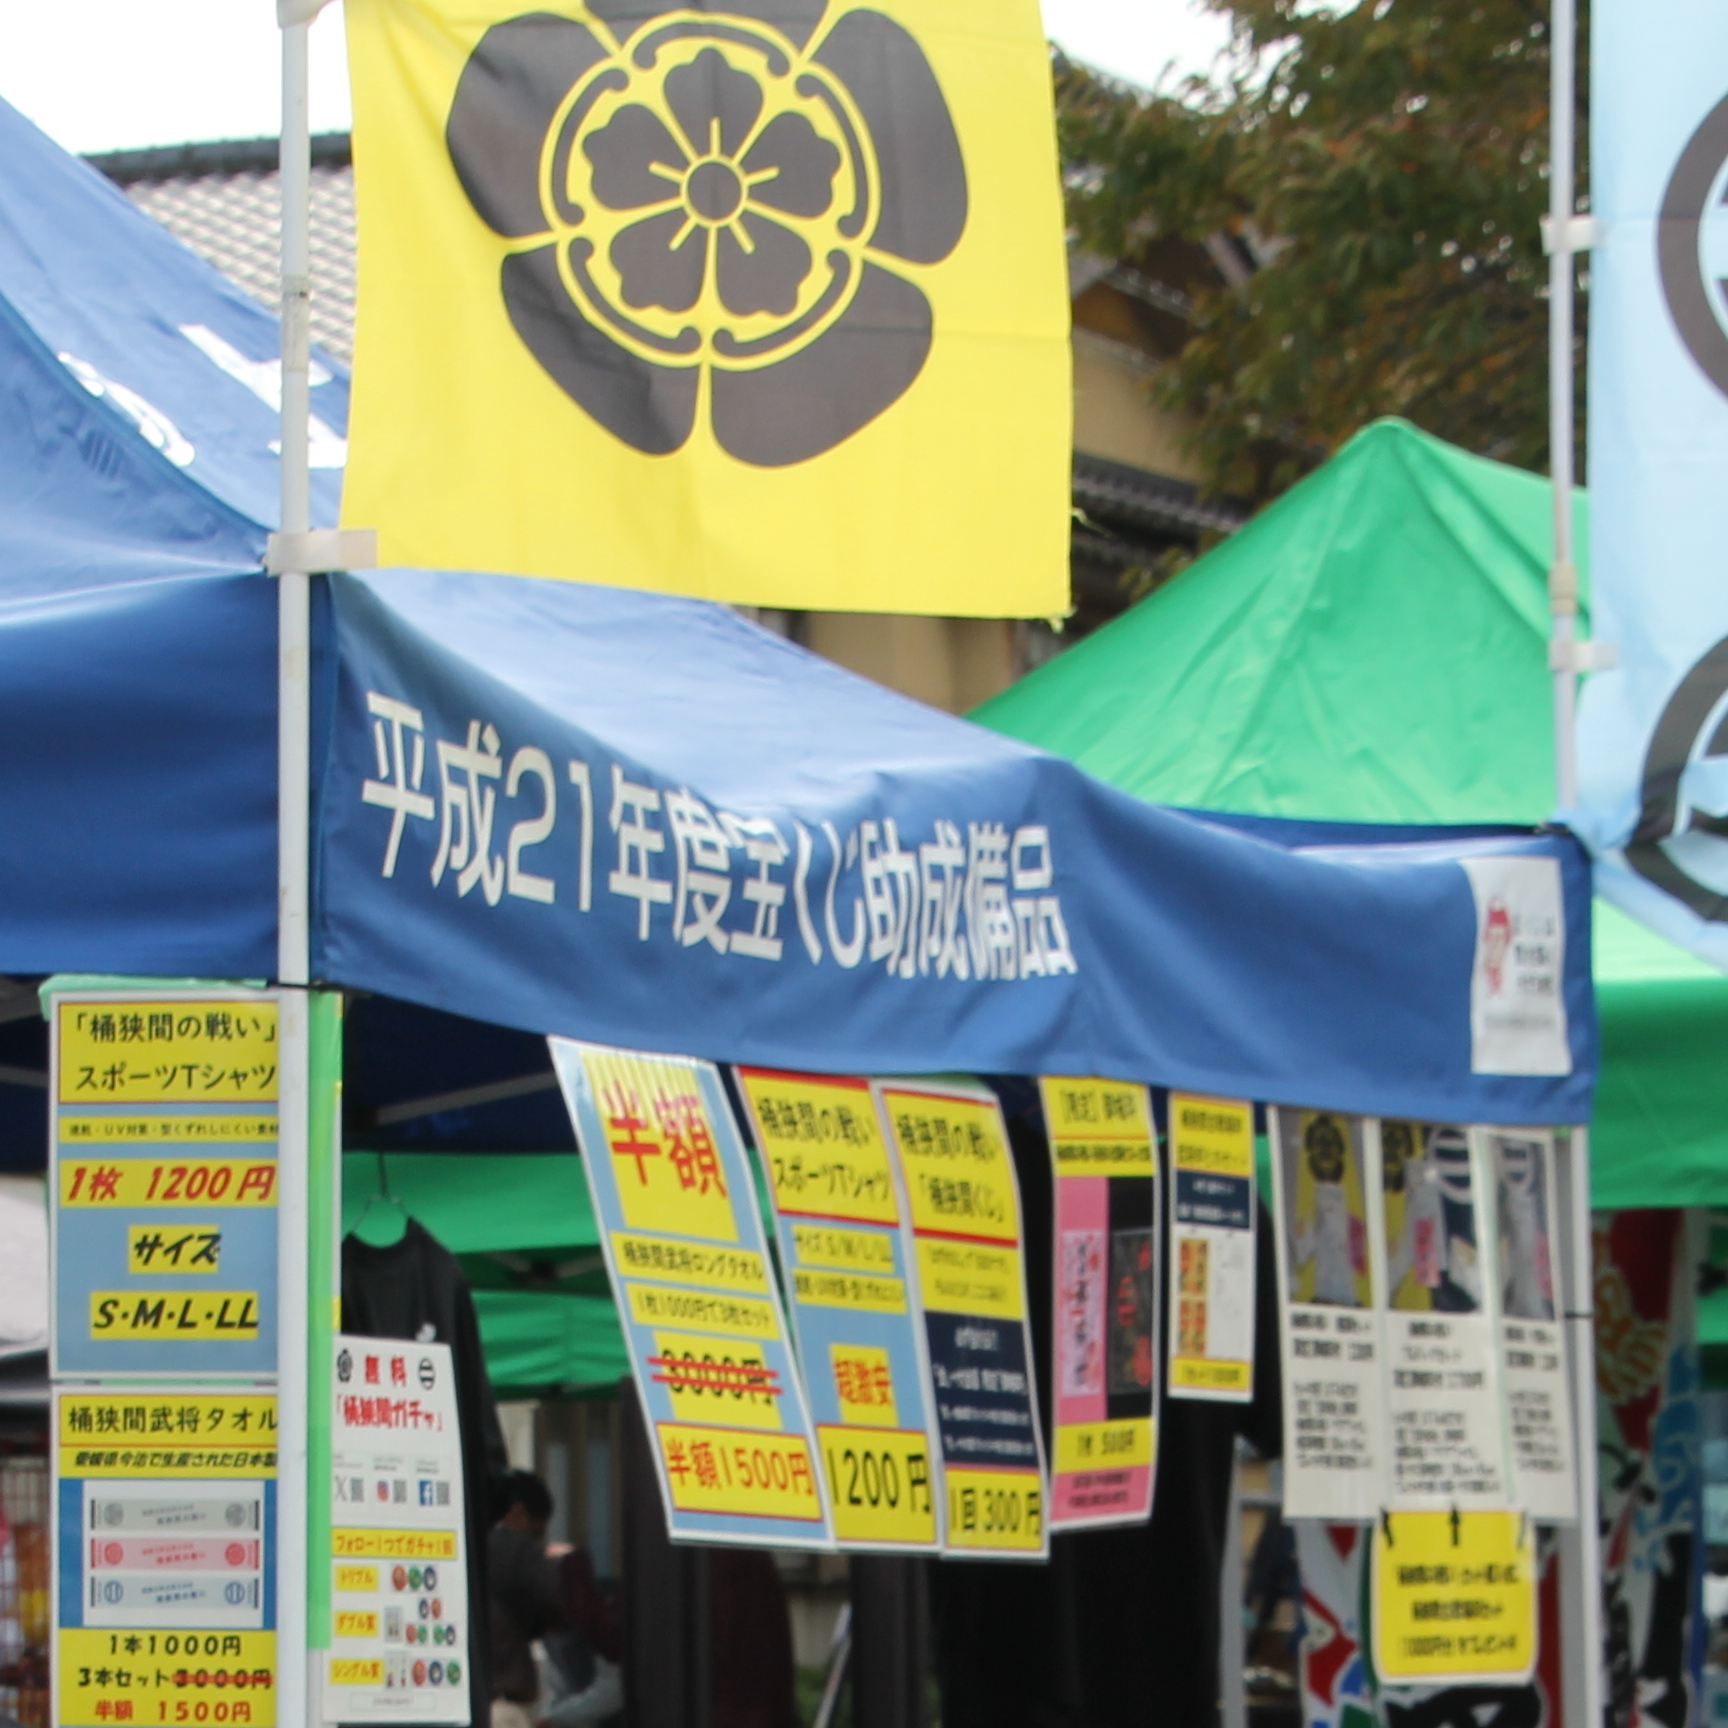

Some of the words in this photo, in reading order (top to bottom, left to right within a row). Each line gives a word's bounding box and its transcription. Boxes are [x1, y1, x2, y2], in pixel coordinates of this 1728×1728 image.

[362, 691, 1078, 981] 平成21年度宝くじ助成備品
[75, 1012, 276, 1043] 「桶狭間の戦い」
[75, 1061, 277, 1092] スポーツTシャツ
[601, 1080, 728, 1199] 半額
[68, 1166, 124, 1202] 1枚
[146, 1165, 277, 1202] 1200円
[134, 1233, 221, 1266] サイズ
[69, 1405, 277, 1434] 桶狭間武将タオル
[666, 1436, 815, 1499] 半額1500円
[110, 1635, 241, 1657] 1本1000円
[95, 1700, 133, 1720] 半額
[159, 1700, 251, 1723] 1500円
